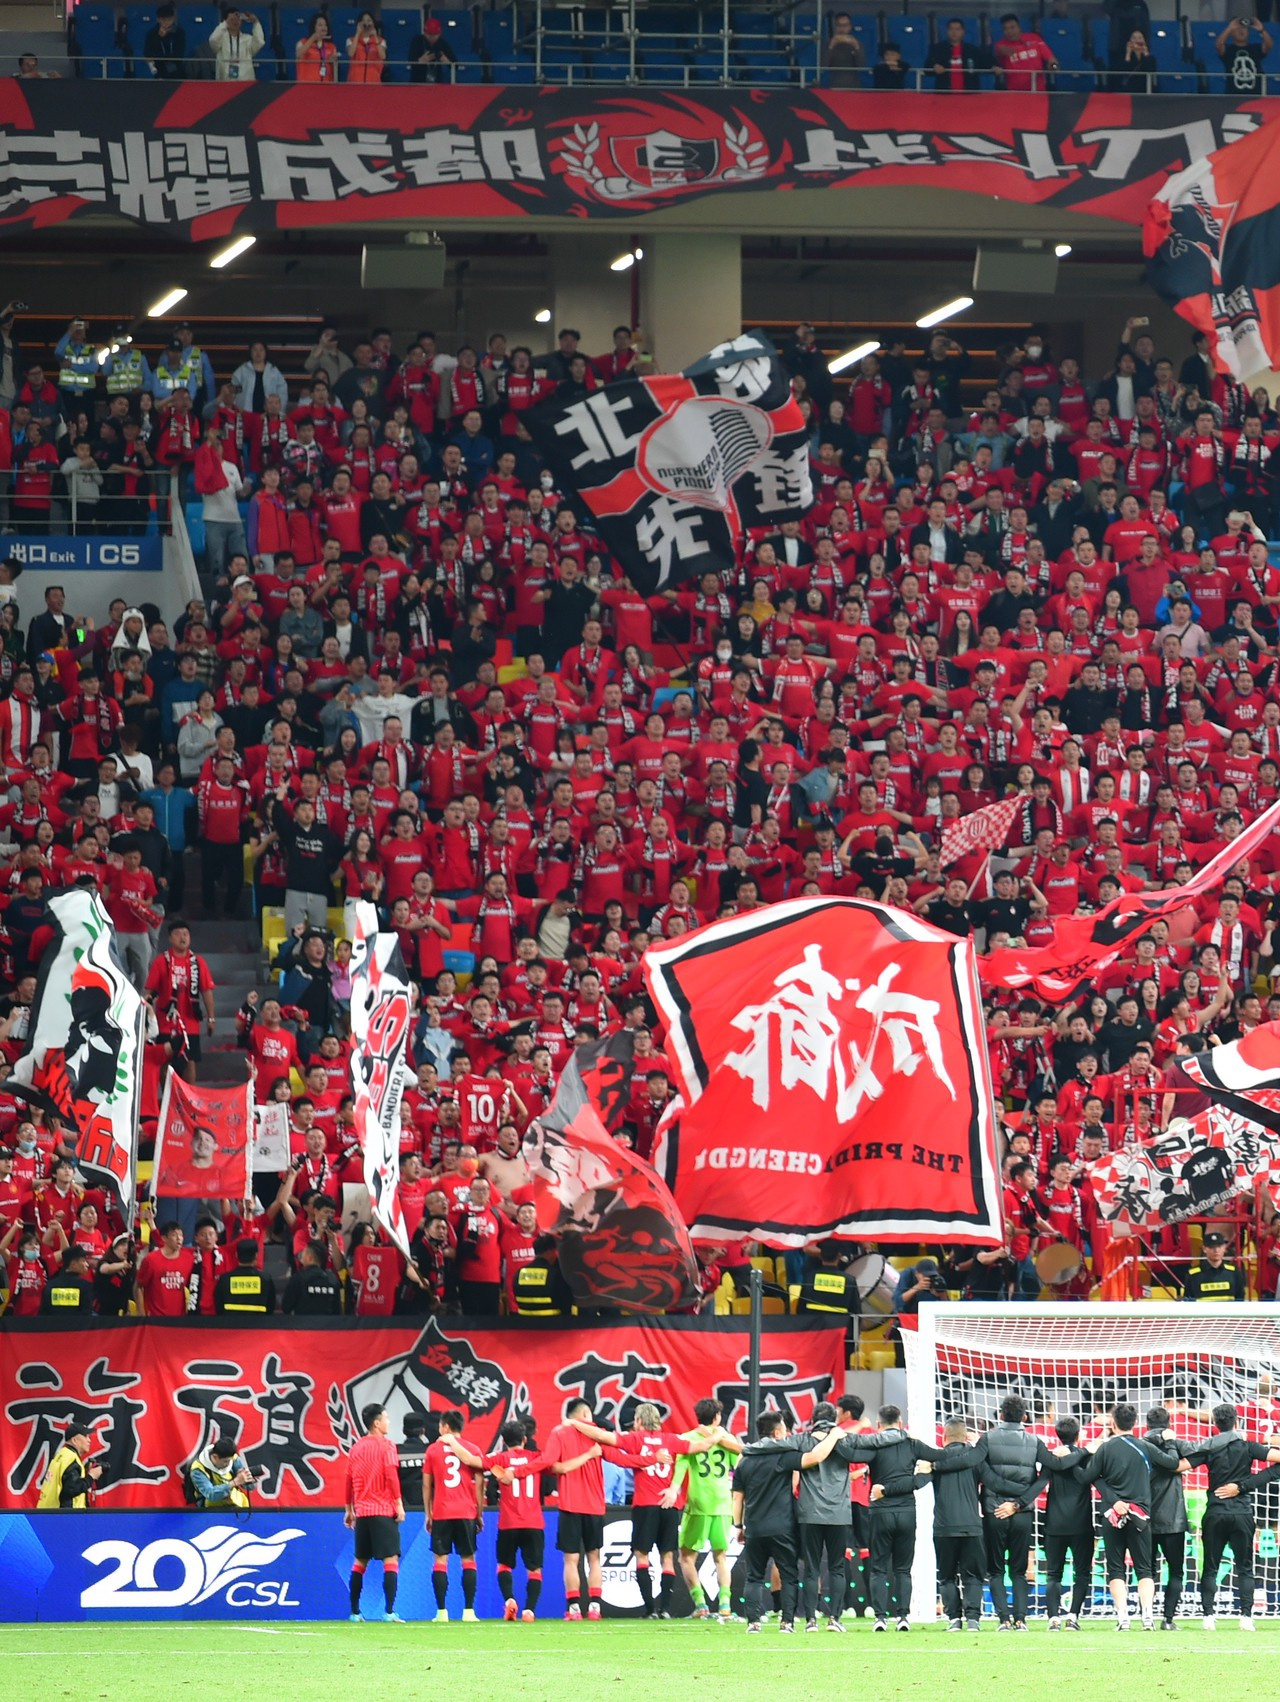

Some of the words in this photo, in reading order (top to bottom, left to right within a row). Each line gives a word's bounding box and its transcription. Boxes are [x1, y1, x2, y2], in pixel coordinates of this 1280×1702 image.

[553, 391, 641, 471] 北
[9, 543, 47, 563] 出口
[50, 551, 76, 563] Exit
[100, 543, 140, 565] C5
[466, 1094, 495, 1123] 10
[366, 1263, 381, 1292] 8
[444, 1454, 462, 1488] 3
[698, 1449, 726, 1478] 33
[512, 1472, 535, 1498] 11
[80, 1538, 207, 1608] 20
[226, 1581, 300, 1607] CSL
[601, 1570, 656, 1582] SPORS
